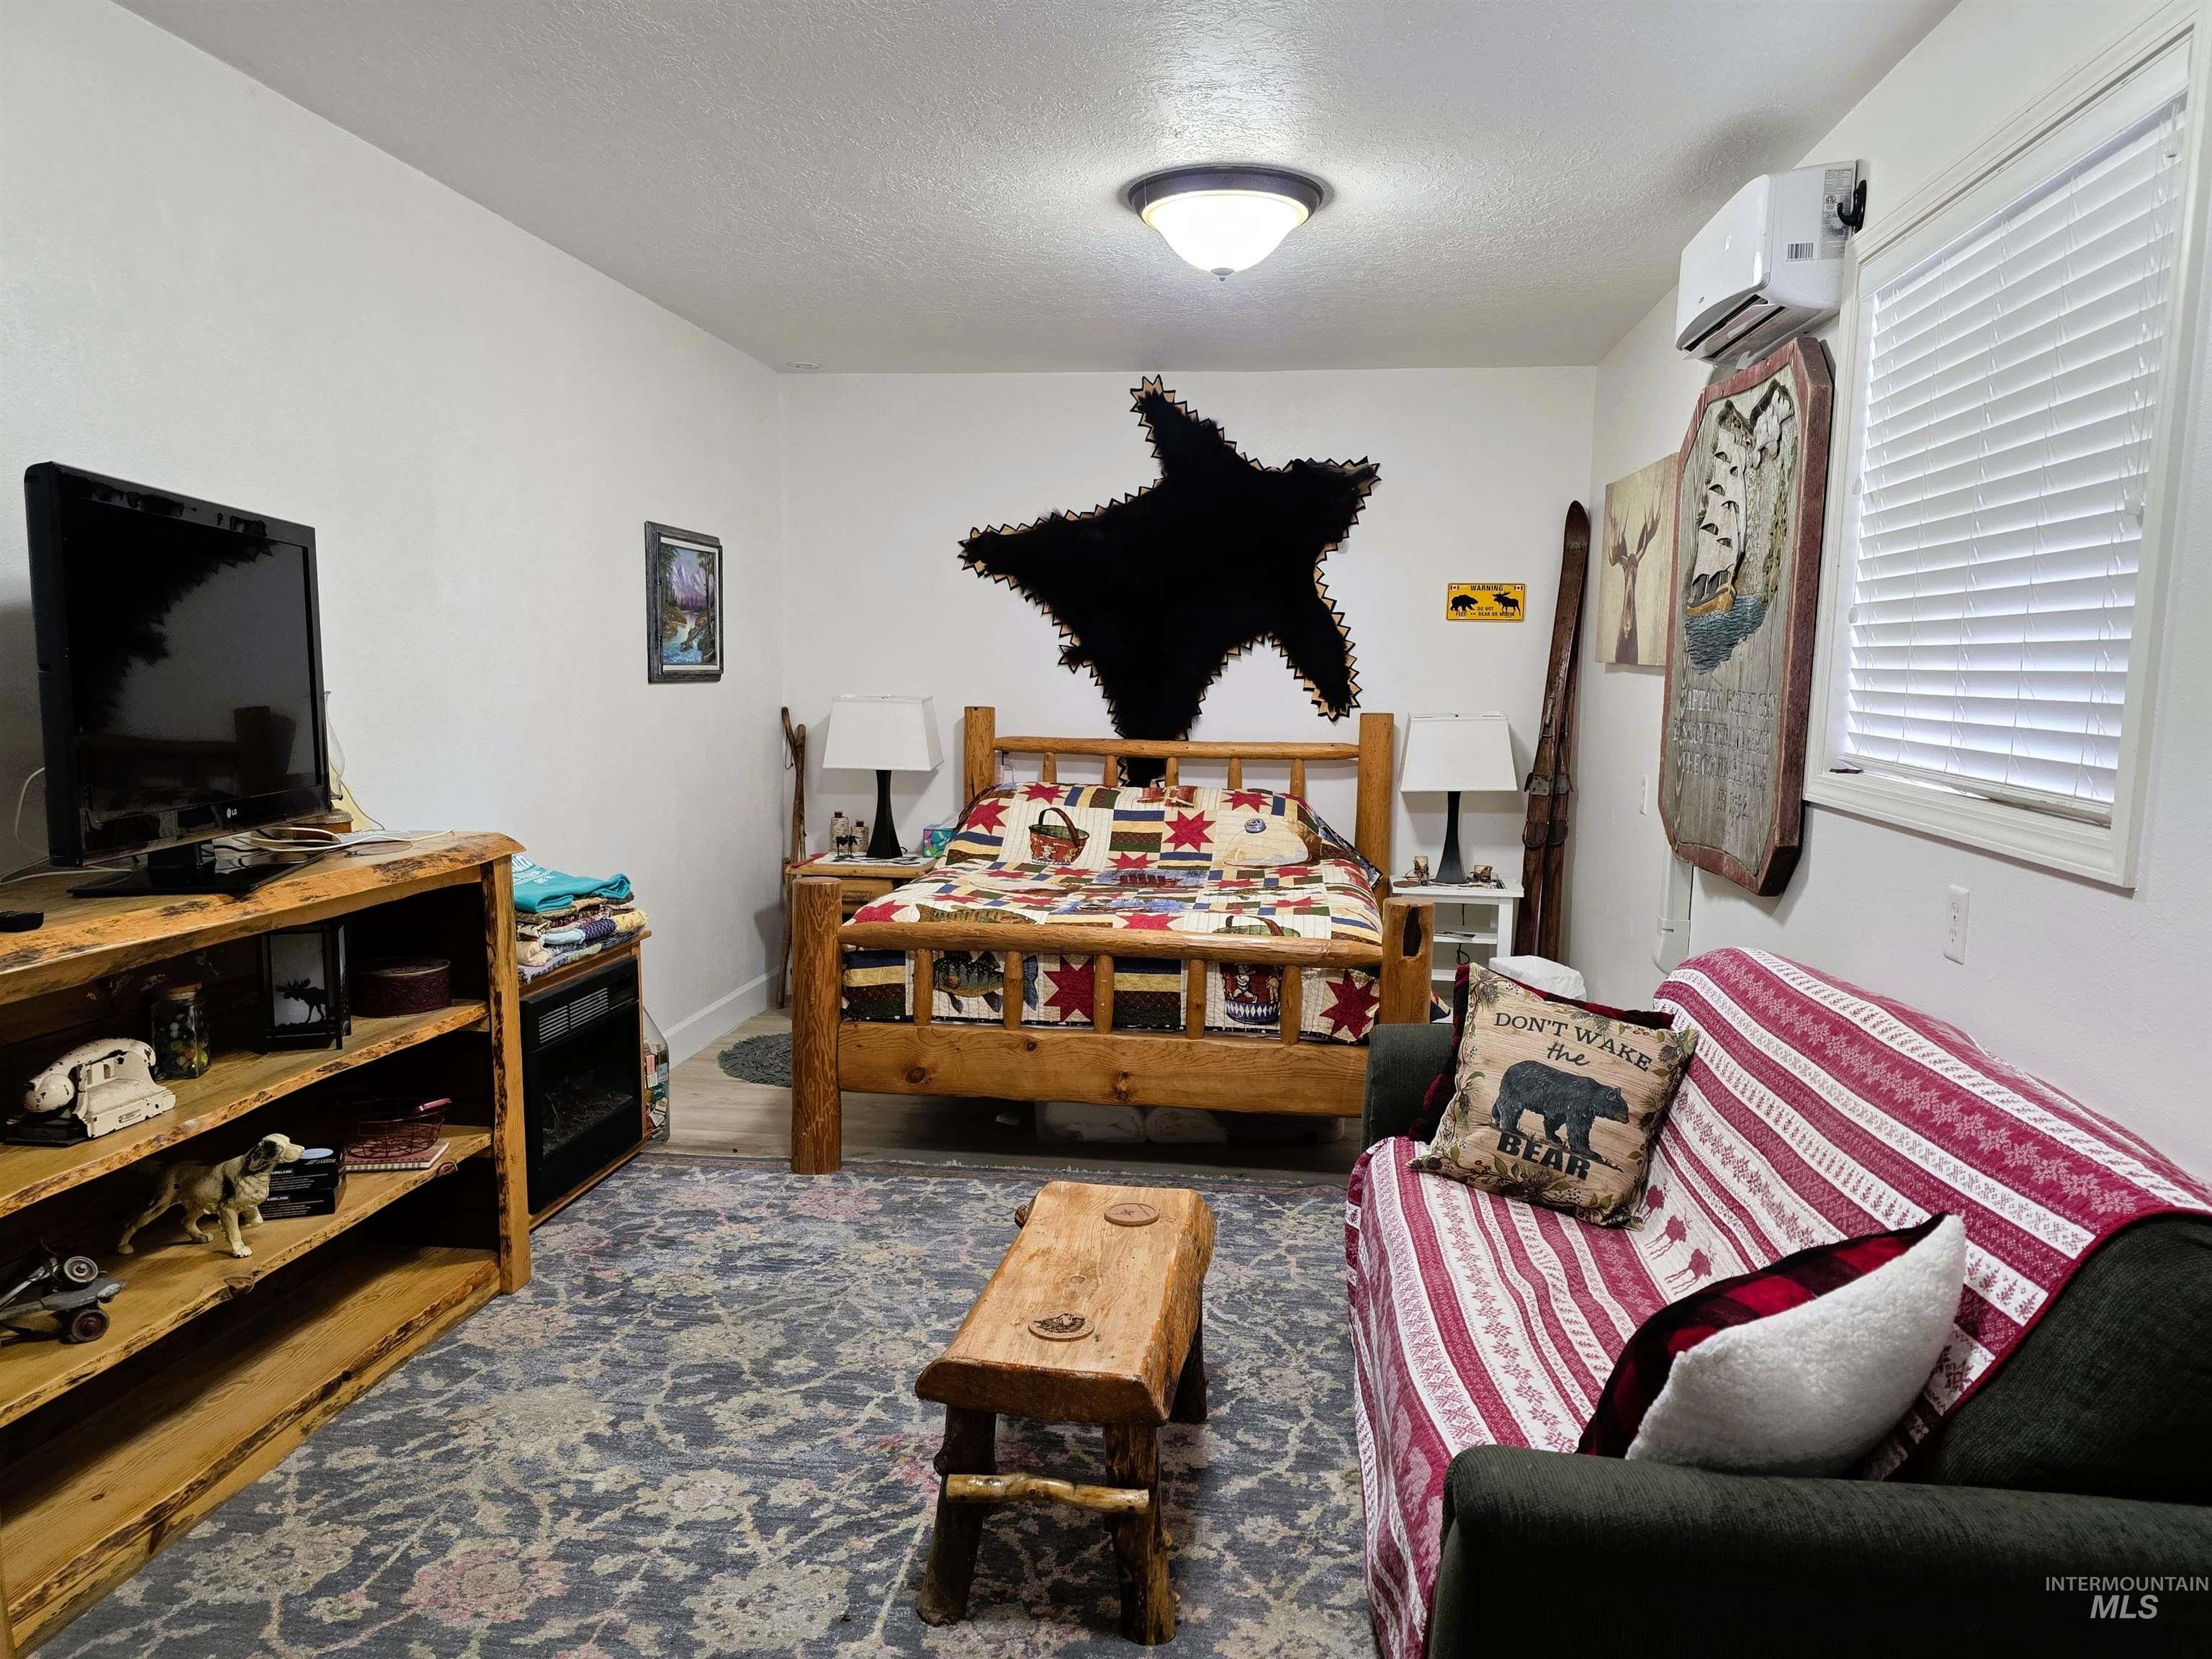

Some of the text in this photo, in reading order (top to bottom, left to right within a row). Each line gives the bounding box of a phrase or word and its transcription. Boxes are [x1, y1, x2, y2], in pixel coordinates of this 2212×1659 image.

[1493, 1012, 1653, 1072] DON'T WAKE
[1547, 1041, 1591, 1066] the
[1496, 1132, 1591, 1180] BEAR
